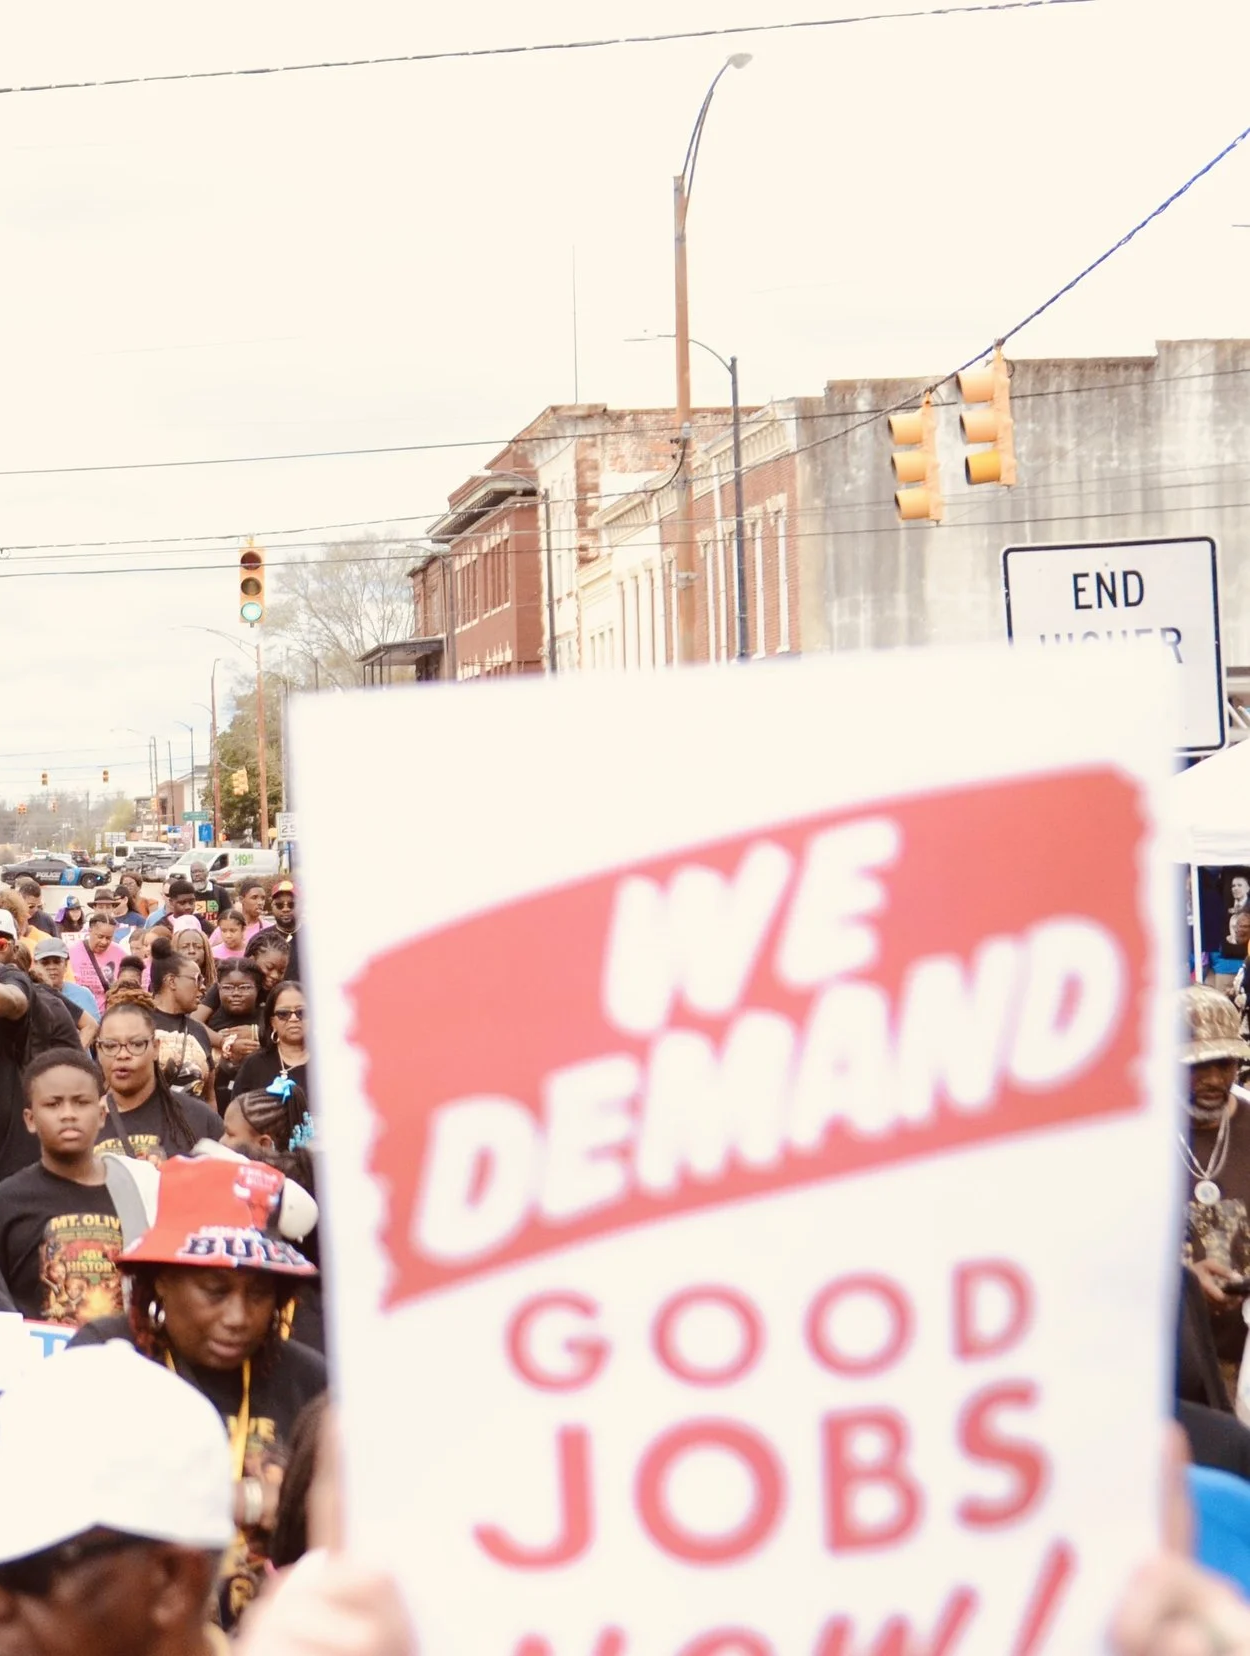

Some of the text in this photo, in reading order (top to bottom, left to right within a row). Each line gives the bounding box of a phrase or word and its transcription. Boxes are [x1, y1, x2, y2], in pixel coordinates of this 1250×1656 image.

[1072, 570, 1145, 610] END
[602, 815, 902, 1036] WE
[408, 916, 1130, 1266] DEMAND
[51, 1214, 121, 1230] MT. OLIV
[502, 1256, 1037, 1394] GOOD
[469, 1377, 1052, 1572] JOBS
